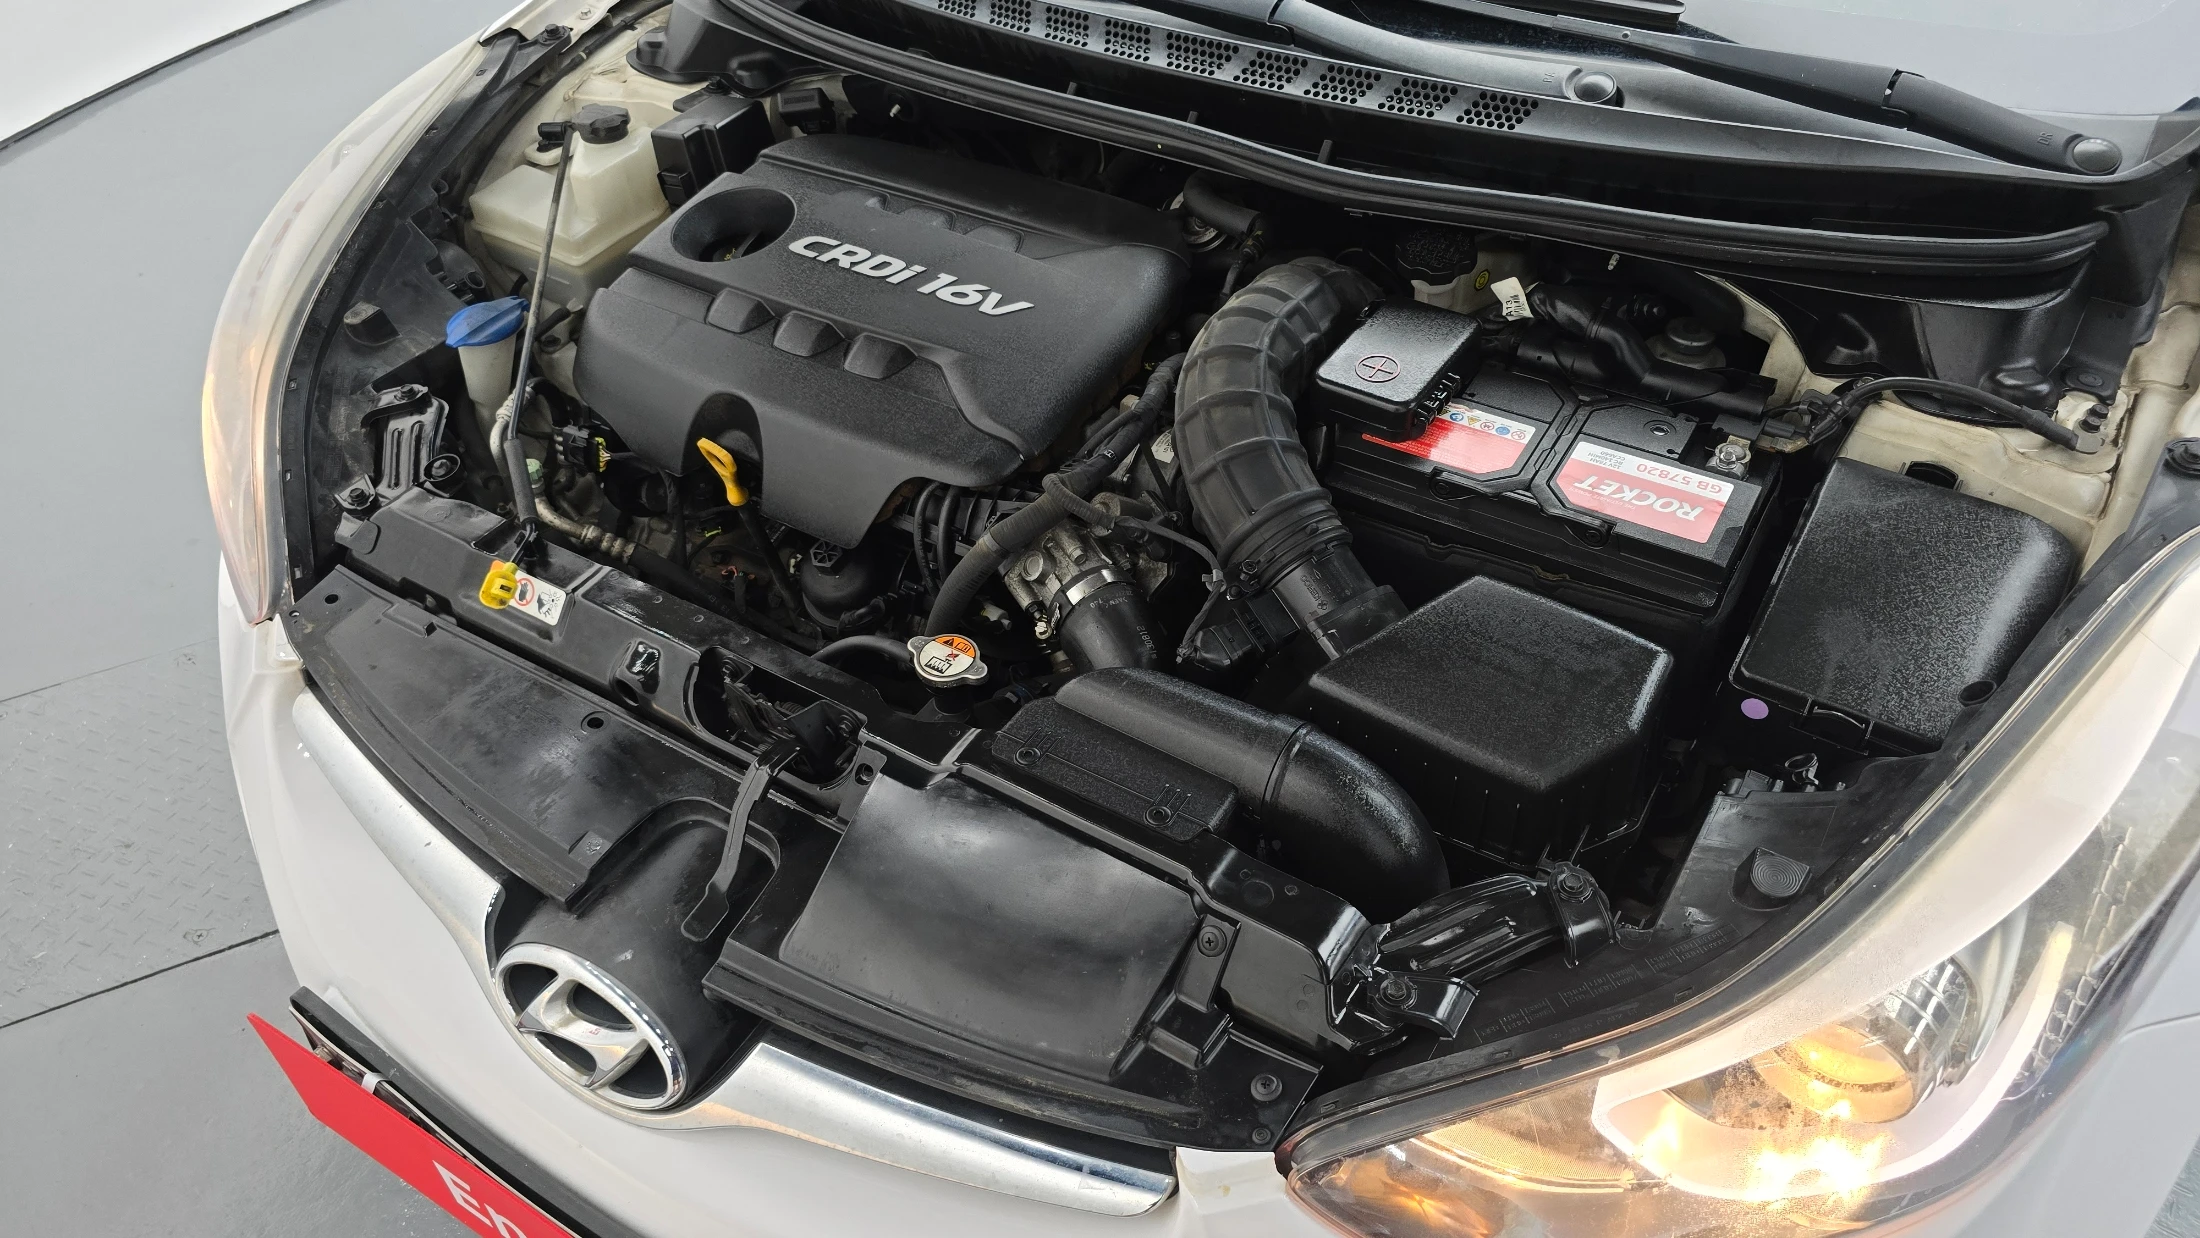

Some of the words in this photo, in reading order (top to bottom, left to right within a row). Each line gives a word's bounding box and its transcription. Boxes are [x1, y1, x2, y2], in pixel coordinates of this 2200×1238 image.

[2037, 131, 2053, 146] DR
[788, 235, 928, 285] CRDi
[917, 272, 1035, 316] 16V
[1505, 299, 1515, 317] A13
[1636, 463, 1693, 488] 57820
[1572, 474, 1705, 522] ROCKET
[1695, 481, 1722, 494] GB
